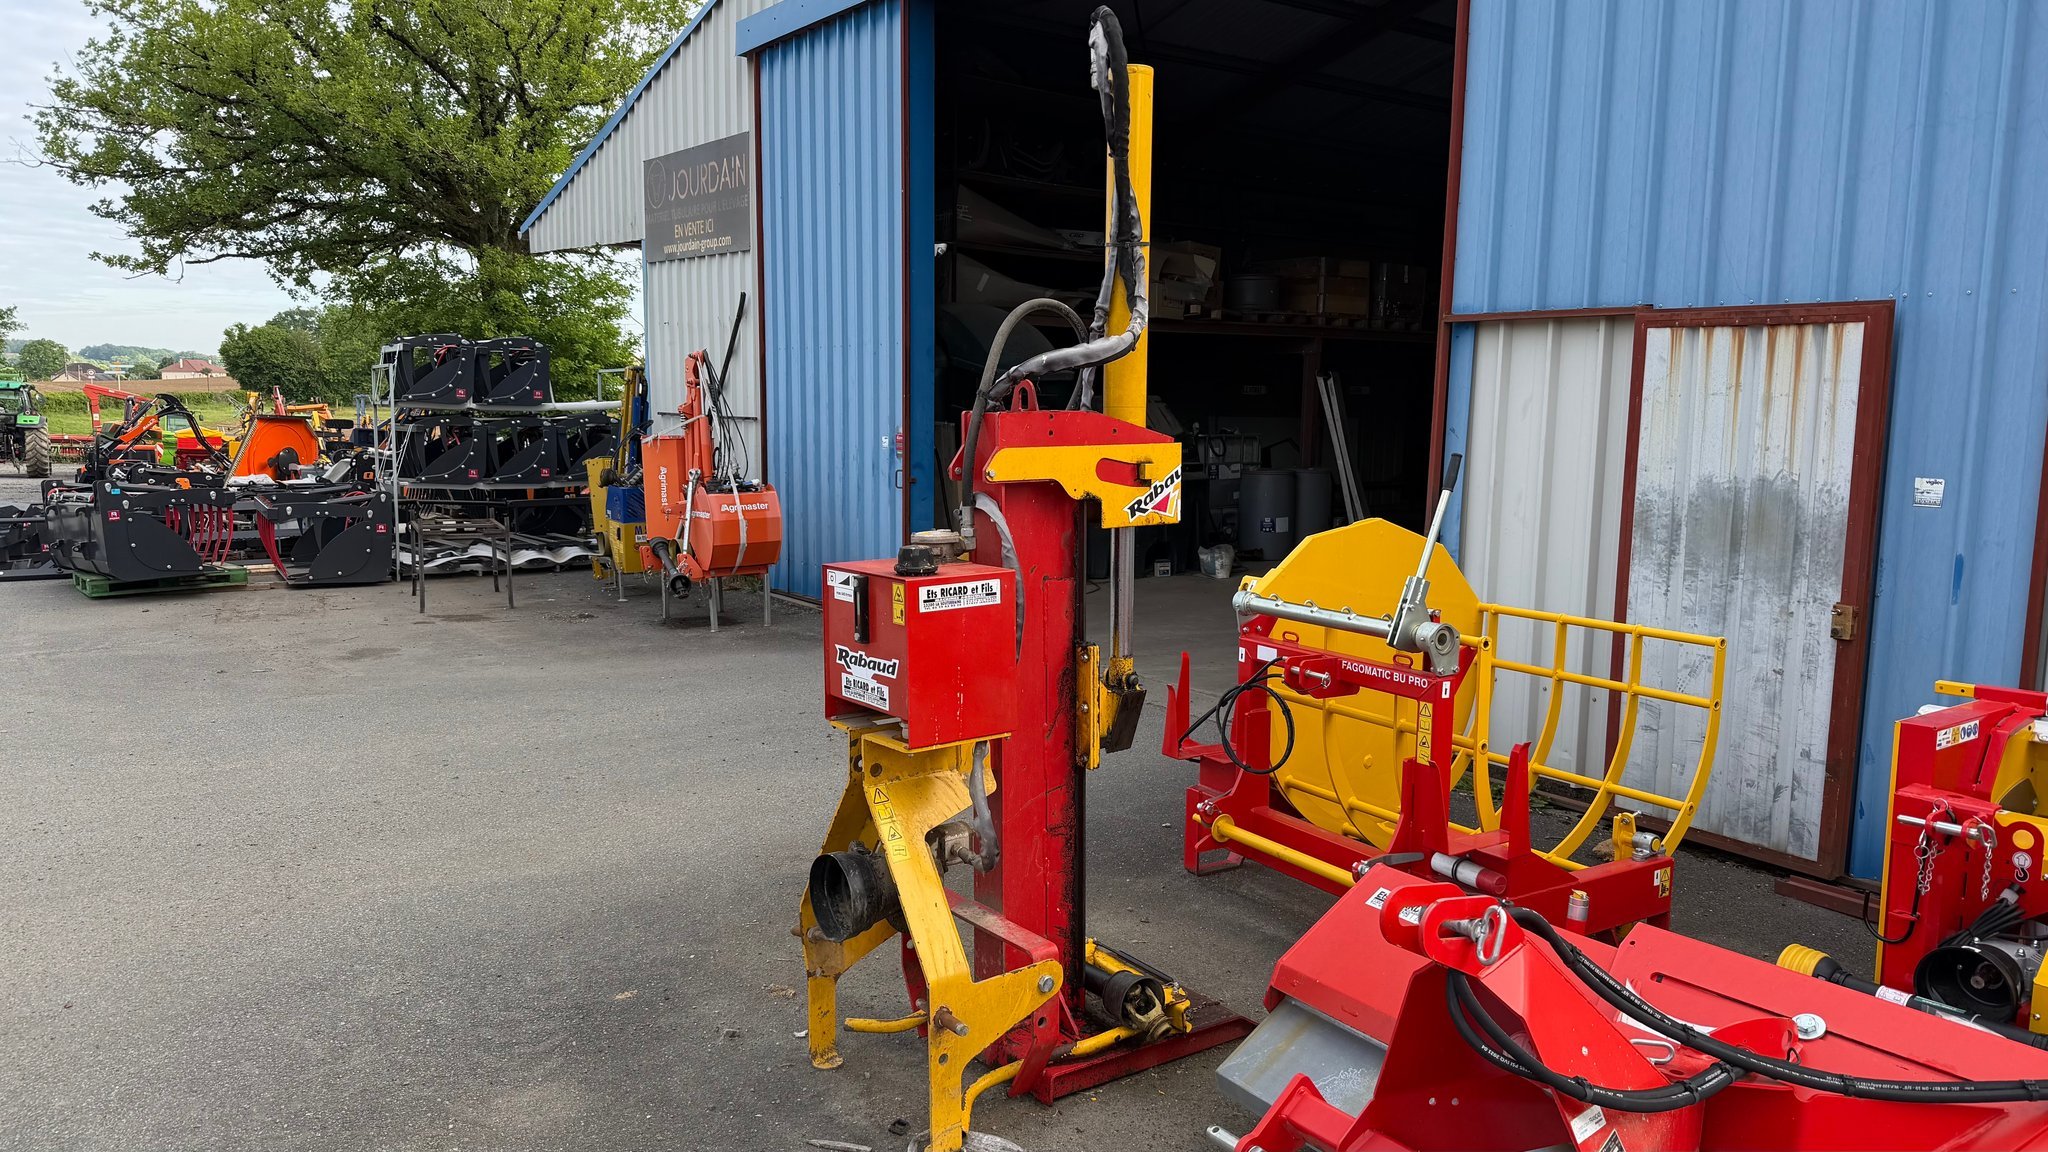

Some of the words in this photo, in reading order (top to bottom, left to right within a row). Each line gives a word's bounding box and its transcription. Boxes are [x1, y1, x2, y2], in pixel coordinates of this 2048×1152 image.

[669, 154, 746, 201] JOURDAIN
[674, 224, 684, 238] EN
[684, 220, 705, 236] VENTE
[705, 218, 714, 233] ICI
[663, 235, 732, 255] www.jourdain-group.com
[658, 466, 668, 506] Agrimast
[720, 503, 769, 513] Agrmaster
[926, 589, 938, 599] Ets
[941, 585, 968, 597] RICARD
[971, 585, 979, 594] et
[981, 582, 994, 593] Fils
[838, 647, 897, 676] Rabaud
[1341, 660, 1391, 680] FAGOMATIC
[1393, 672, 1406, 683] BU
[1408, 675, 1428, 688] PRO
[845, 676, 853, 686] Ets
[853, 678, 870, 692] RICARD
[870, 685, 876, 694] et
[876, 686, 885, 697] Fils
[1376, 890, 1388, 899] Et
